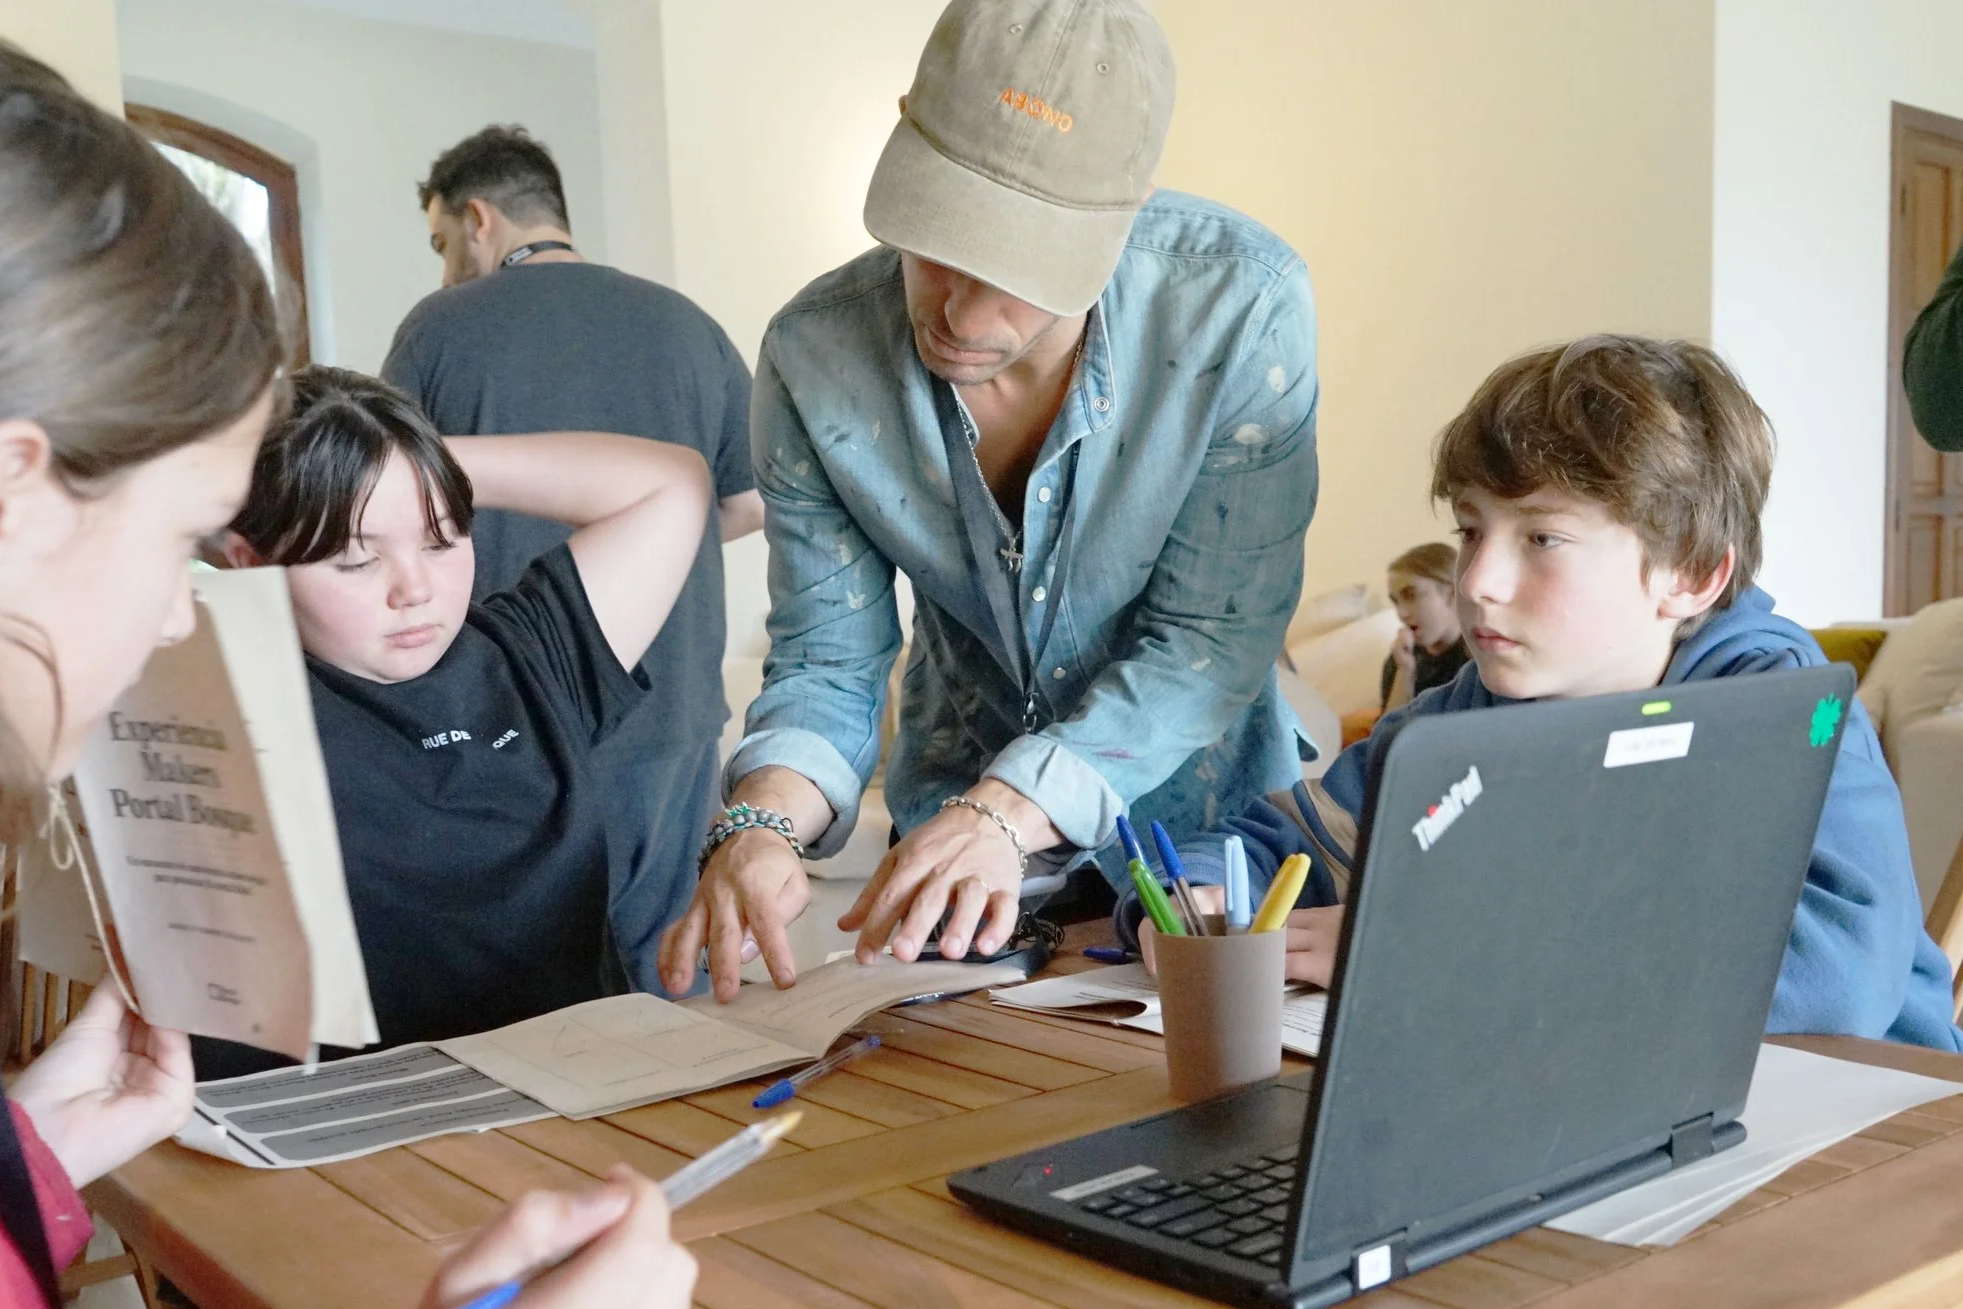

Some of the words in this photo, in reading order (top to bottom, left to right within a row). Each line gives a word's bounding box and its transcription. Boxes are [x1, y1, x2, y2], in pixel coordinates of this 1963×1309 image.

[421, 732, 449, 749] RUE
[450, 730, 472, 742] DE
[108, 788, 186, 822] Portal
